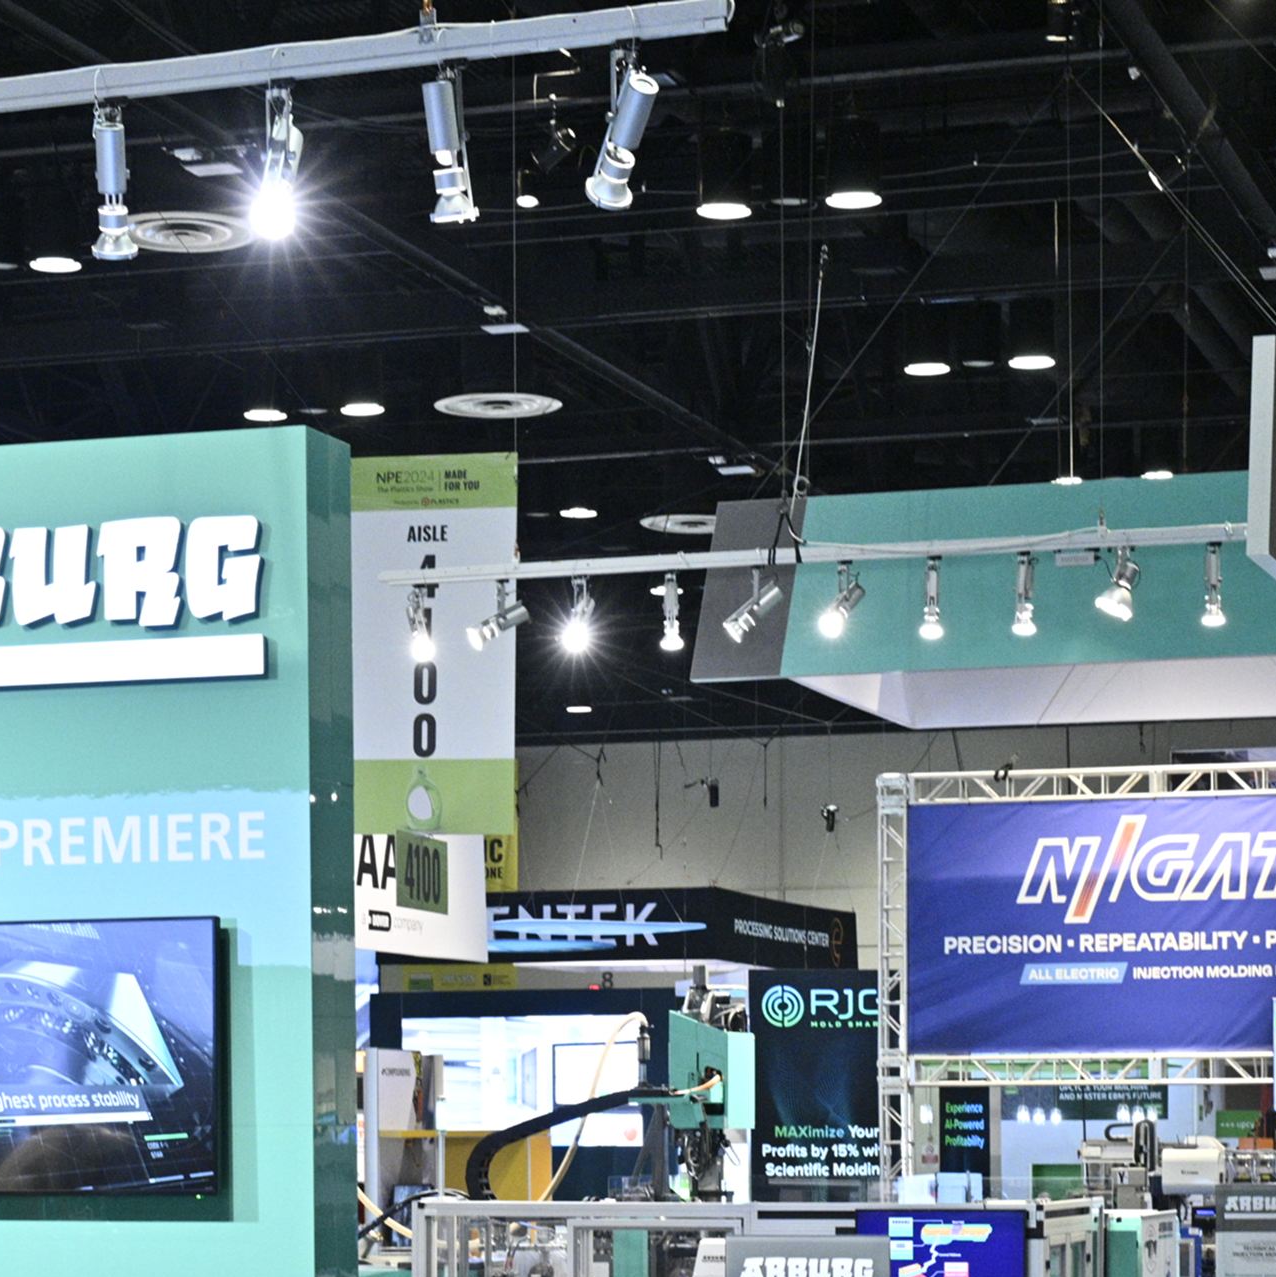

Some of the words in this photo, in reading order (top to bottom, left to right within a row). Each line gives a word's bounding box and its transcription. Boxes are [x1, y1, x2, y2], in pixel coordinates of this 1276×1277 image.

[376, 470, 434, 484] NPE2024
[444, 469, 468, 479] MADE
[444, 482, 460, 491] FOR
[463, 480, 480, 491] YOU
[407, 525, 448, 543] AISLE
[404, 843, 441, 905] 4100
[734, 918, 773, 940] PROCESSING
[773, 925, 807, 944] SOLUTIONS
[807, 930, 830, 947] CENTER
[944, 934, 1062, 955] PRECISION
[1079, 930, 1248, 953] REPEATABILITY
[602, 971, 613, 988] 8
[1028, 967, 1052, 981] ALL
[1054, 967, 1120, 981] ELECTRIC
[1133, 966, 1203, 979] INJECTION
[1206, 965, 1272, 979] MOLDING
[39, 1093, 91, 1111] process
[93, 1090, 139, 1110] stability
[945, 1101, 984, 1115] Experience
[775, 1125, 845, 1138] MAXimize
[848, 1125, 880, 1138] Your
[762, 1143, 808, 1158] Profits
[811, 1143, 829, 1160] by
[831, 1143, 859, 1158] 15%
[765, 1162, 830, 1177] Scientific
[833, 1162, 880, 1177] Moldin
